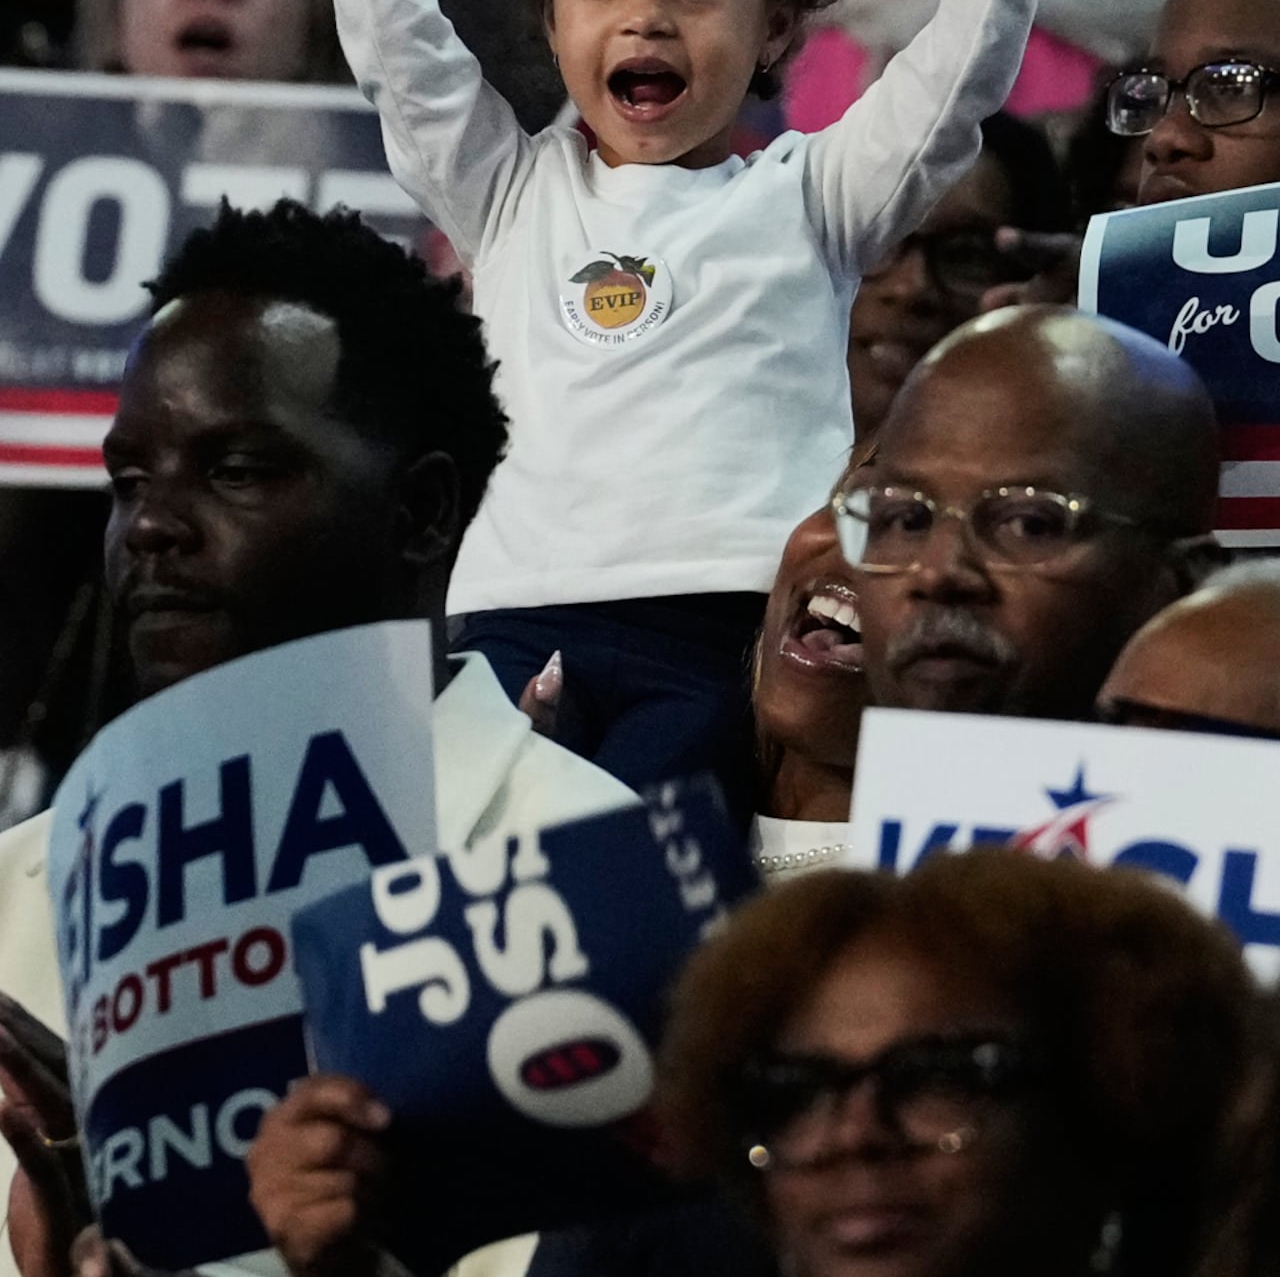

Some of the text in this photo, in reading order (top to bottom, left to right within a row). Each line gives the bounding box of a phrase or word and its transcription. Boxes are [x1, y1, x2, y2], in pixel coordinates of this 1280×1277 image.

[589, 291, 641, 312] EVIP
[1167, 296, 1241, 358] for
[583, 326, 611, 344] VOTE
[613, 334, 626, 345] IN
[63, 727, 410, 988] ISHA
[92, 1086, 282, 1202] RNO
